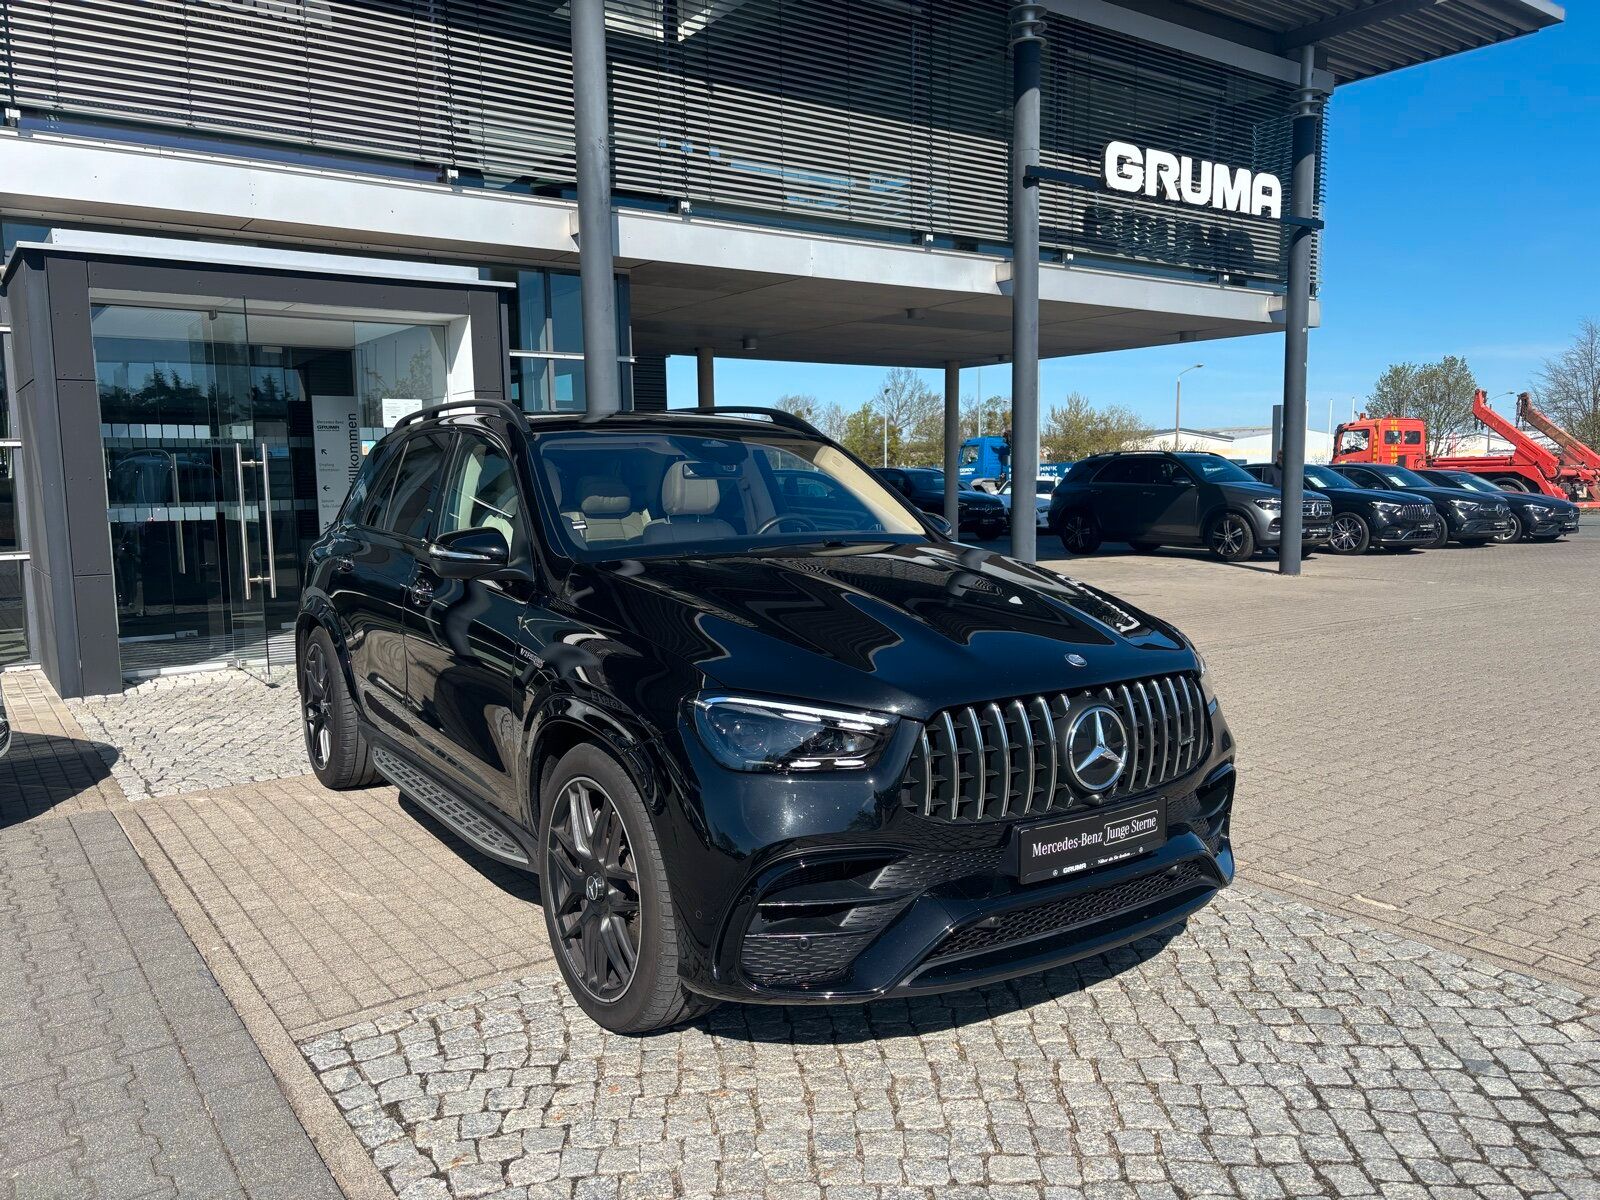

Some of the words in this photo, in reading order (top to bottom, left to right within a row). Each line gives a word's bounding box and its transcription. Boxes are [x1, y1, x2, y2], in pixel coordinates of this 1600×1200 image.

[1104, 140, 1282, 219] GRUMA
[348, 413, 360, 487] illkommen
[1031, 831, 1103, 858] Mercedes-Benz
[1105, 826, 1130, 842] Junge
[1131, 816, 1157, 833] Sterne
[1062, 862, 1087, 874] GRUMA
